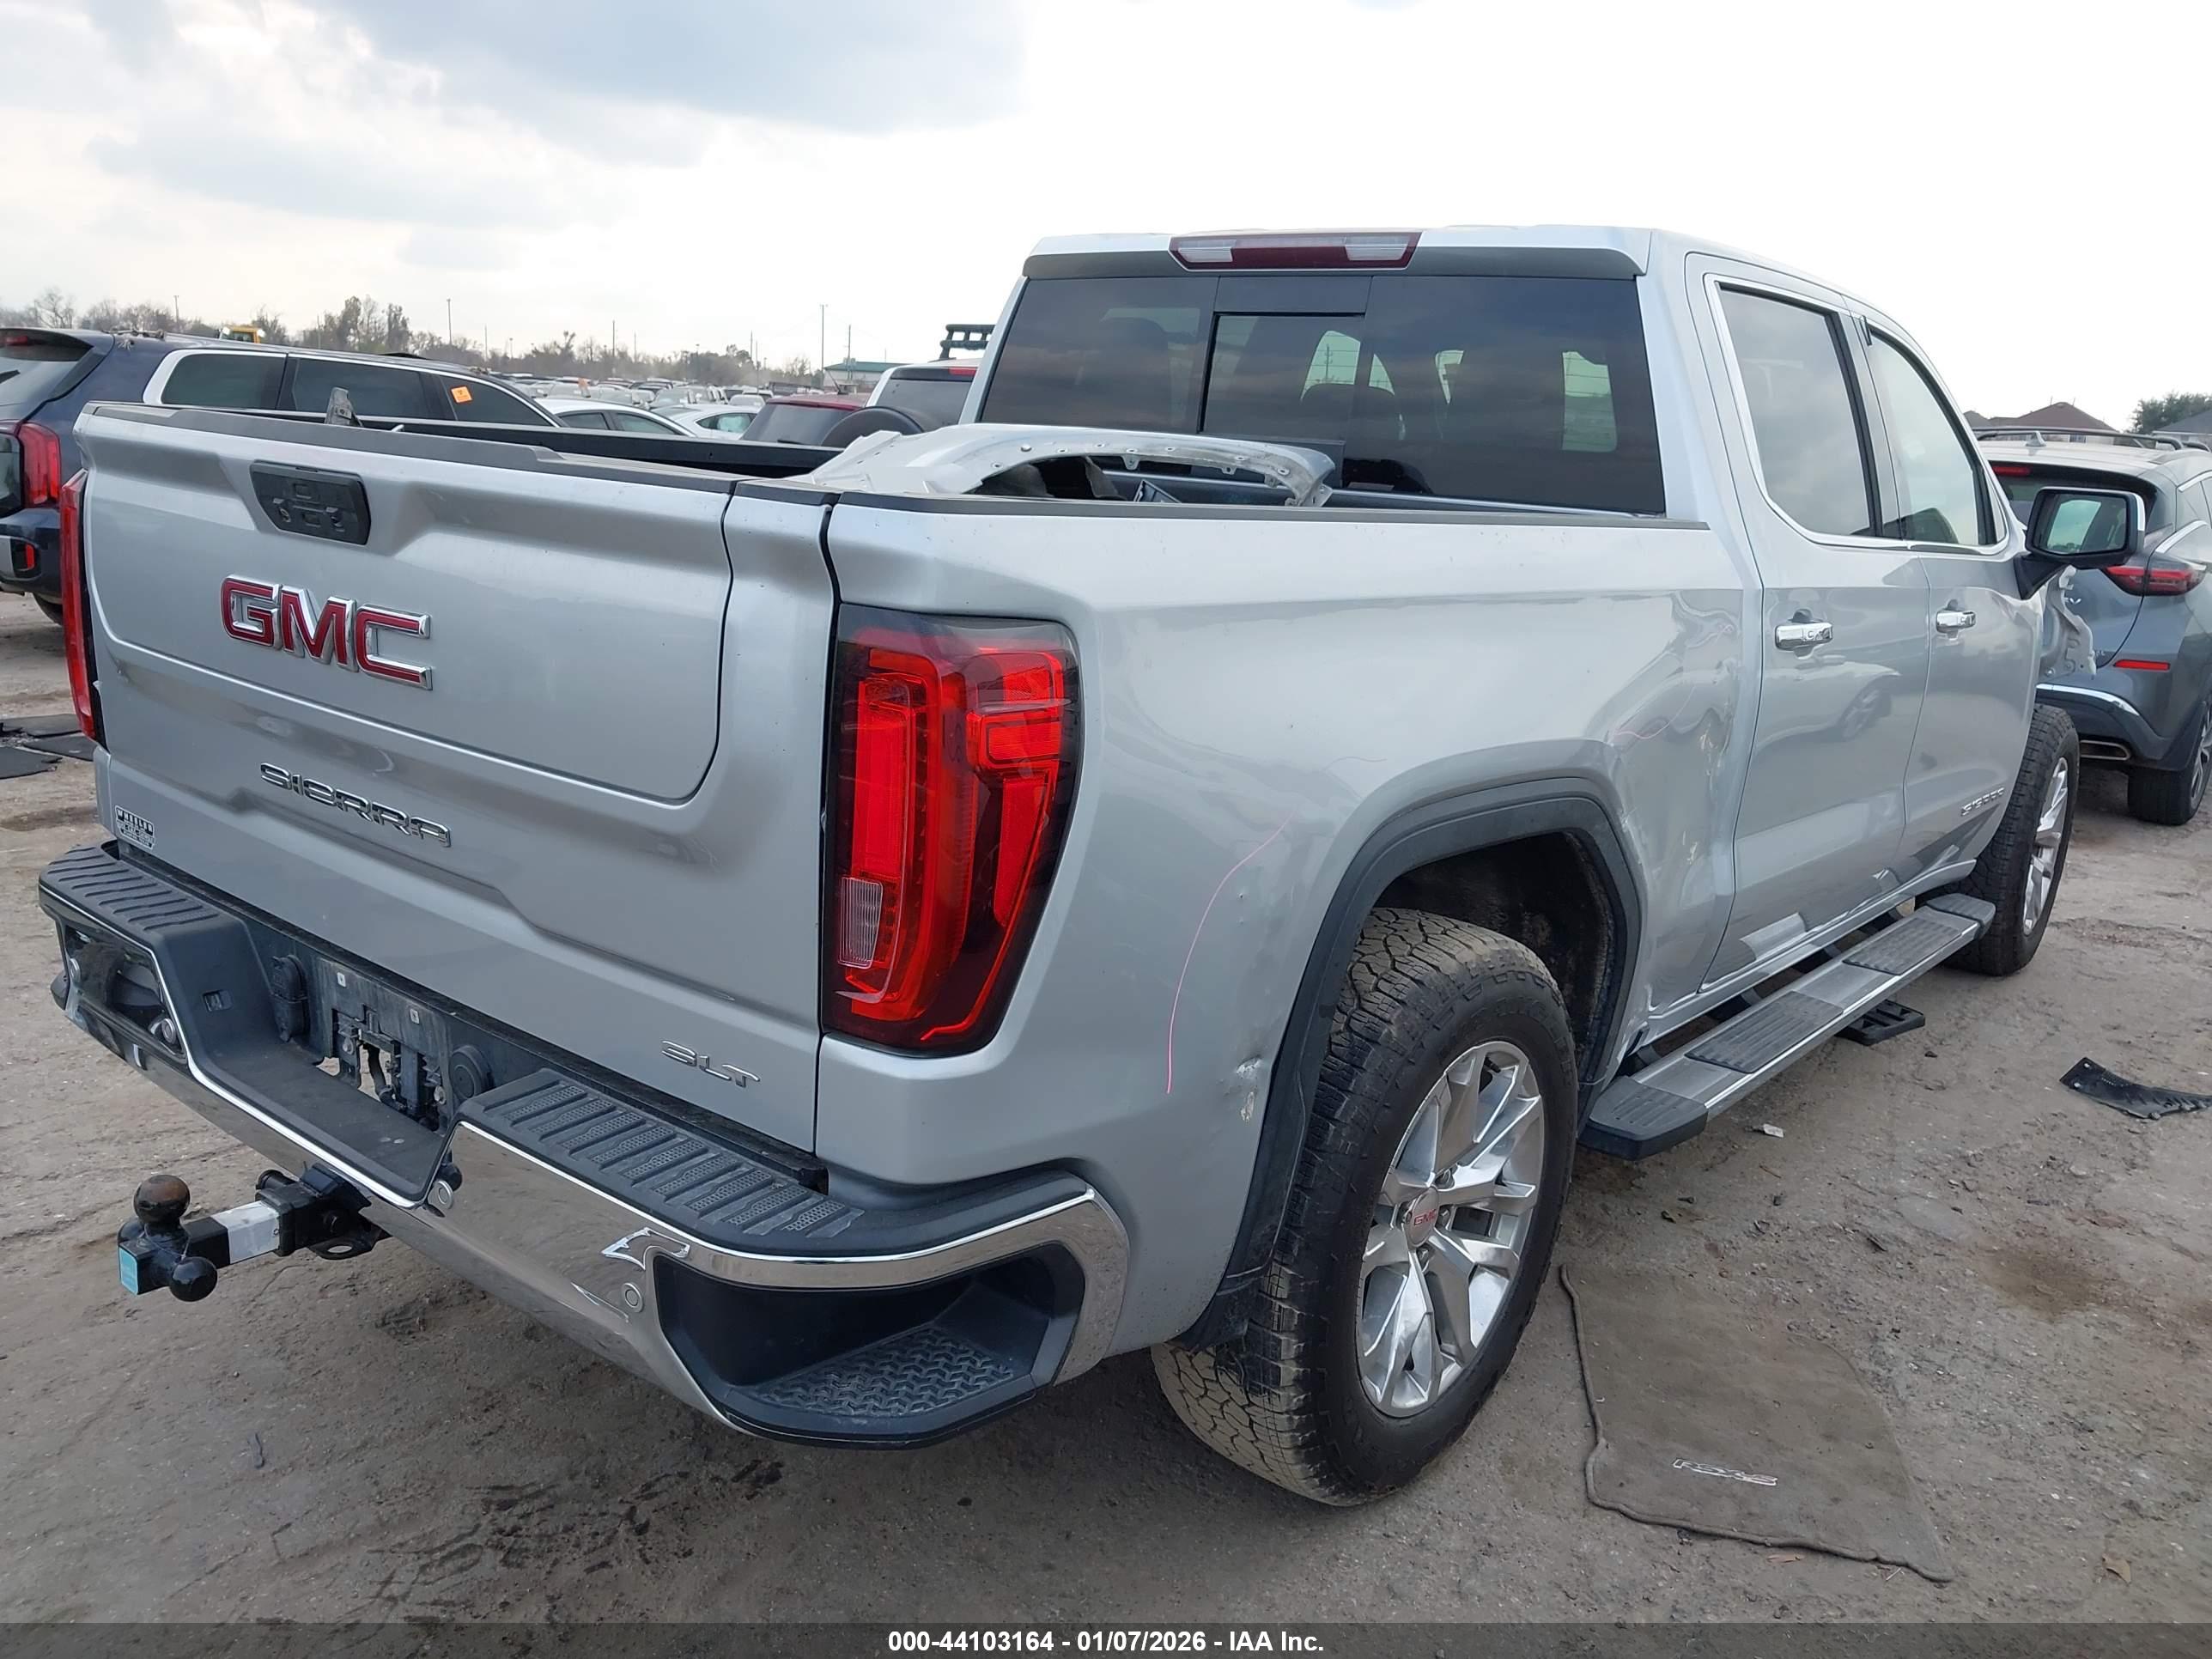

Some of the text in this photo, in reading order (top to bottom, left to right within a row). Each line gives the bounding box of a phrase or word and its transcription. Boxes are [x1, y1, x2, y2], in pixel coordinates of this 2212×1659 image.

[220, 574, 433, 690] GMC
[260, 763, 451, 848] SIERRA
[660, 1039, 761, 1088] SLT
